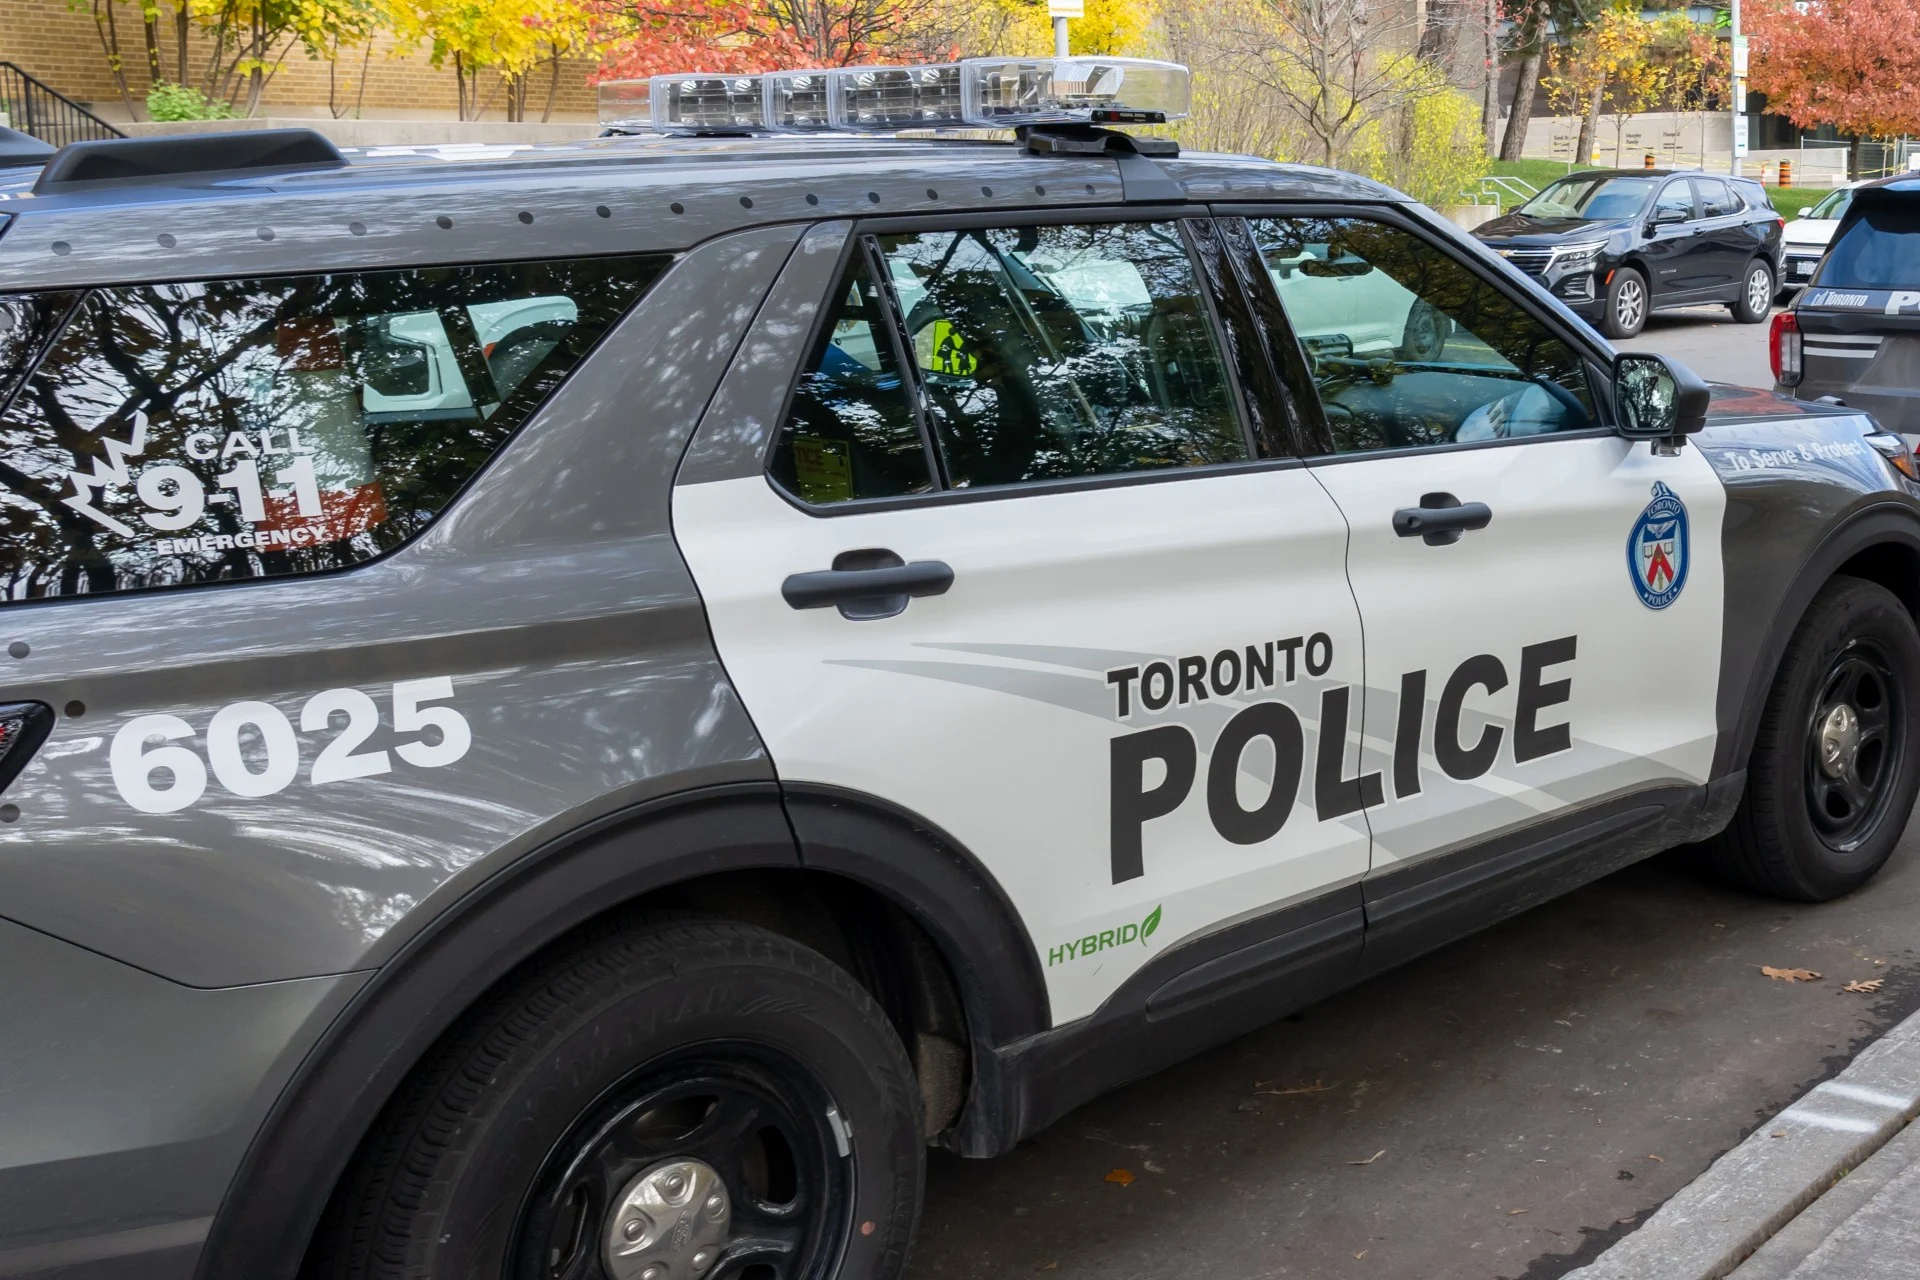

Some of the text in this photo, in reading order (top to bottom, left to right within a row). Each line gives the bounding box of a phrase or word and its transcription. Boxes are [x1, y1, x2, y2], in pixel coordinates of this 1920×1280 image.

[1824, 291, 1868, 307] TORONTO
[1885, 291, 1920, 315] P
[185, 428, 315, 459] CALL
[1724, 440, 1868, 472] To Serve & Protect
[137, 455, 323, 530] 9-1-1
[1647, 500, 1681, 517] TORONTO
[156, 526, 326, 555] EMERGENCY
[1648, 591, 1674, 606] POLICE
[1107, 632, 1333, 718] TORONTO
[110, 676, 472, 813] 6025
[1110, 634, 1577, 885] POLICE
[1048, 922, 1137, 967] HYBRID
